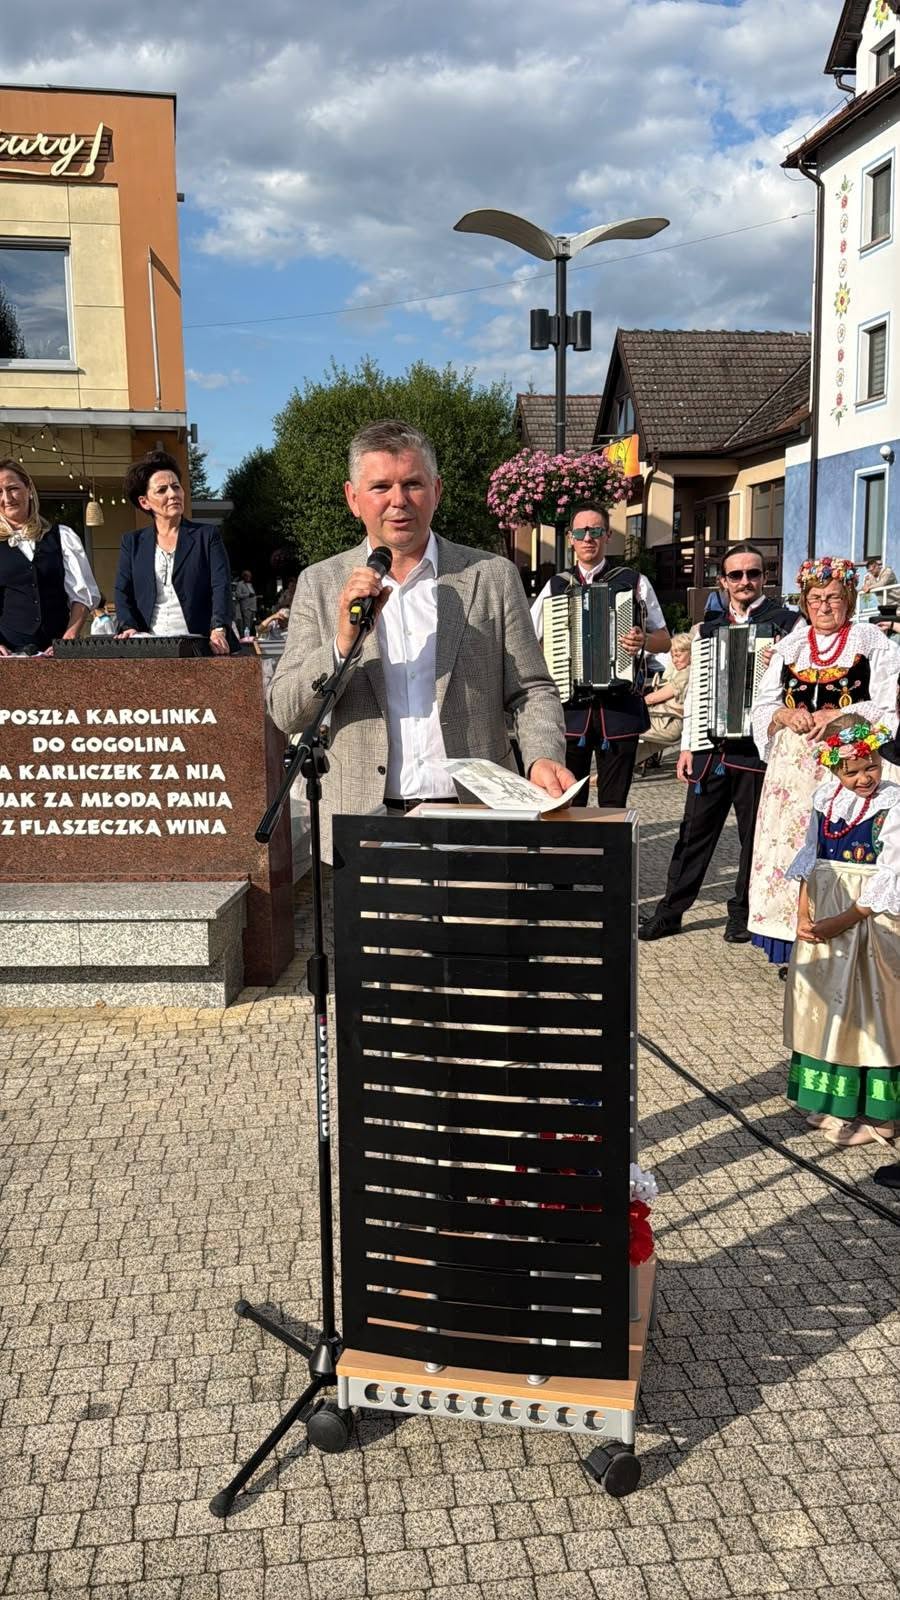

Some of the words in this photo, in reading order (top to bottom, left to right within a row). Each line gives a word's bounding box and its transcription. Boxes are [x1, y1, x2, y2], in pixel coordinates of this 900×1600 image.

[0, 709, 80, 725] POSZŁA
[86, 708, 217, 725] KAROLINKA
[32, 737, 65, 753] DO
[71, 736, 186, 753] GOGOLINA
[0, 764, 13, 780] A
[19, 764, 143, 780] KARLICZEK
[149, 764, 180, 780] ZA
[186, 764, 226, 782] NIĄ
[43, 792, 74, 808] ZA
[81, 792, 162, 810] MŁODĄ
[167, 791, 233, 810] PANIĄ
[1, 819, 16, 836] Z
[20, 819, 162, 837] FLASZECZKĄ
[165, 819, 227, 835] WINA
